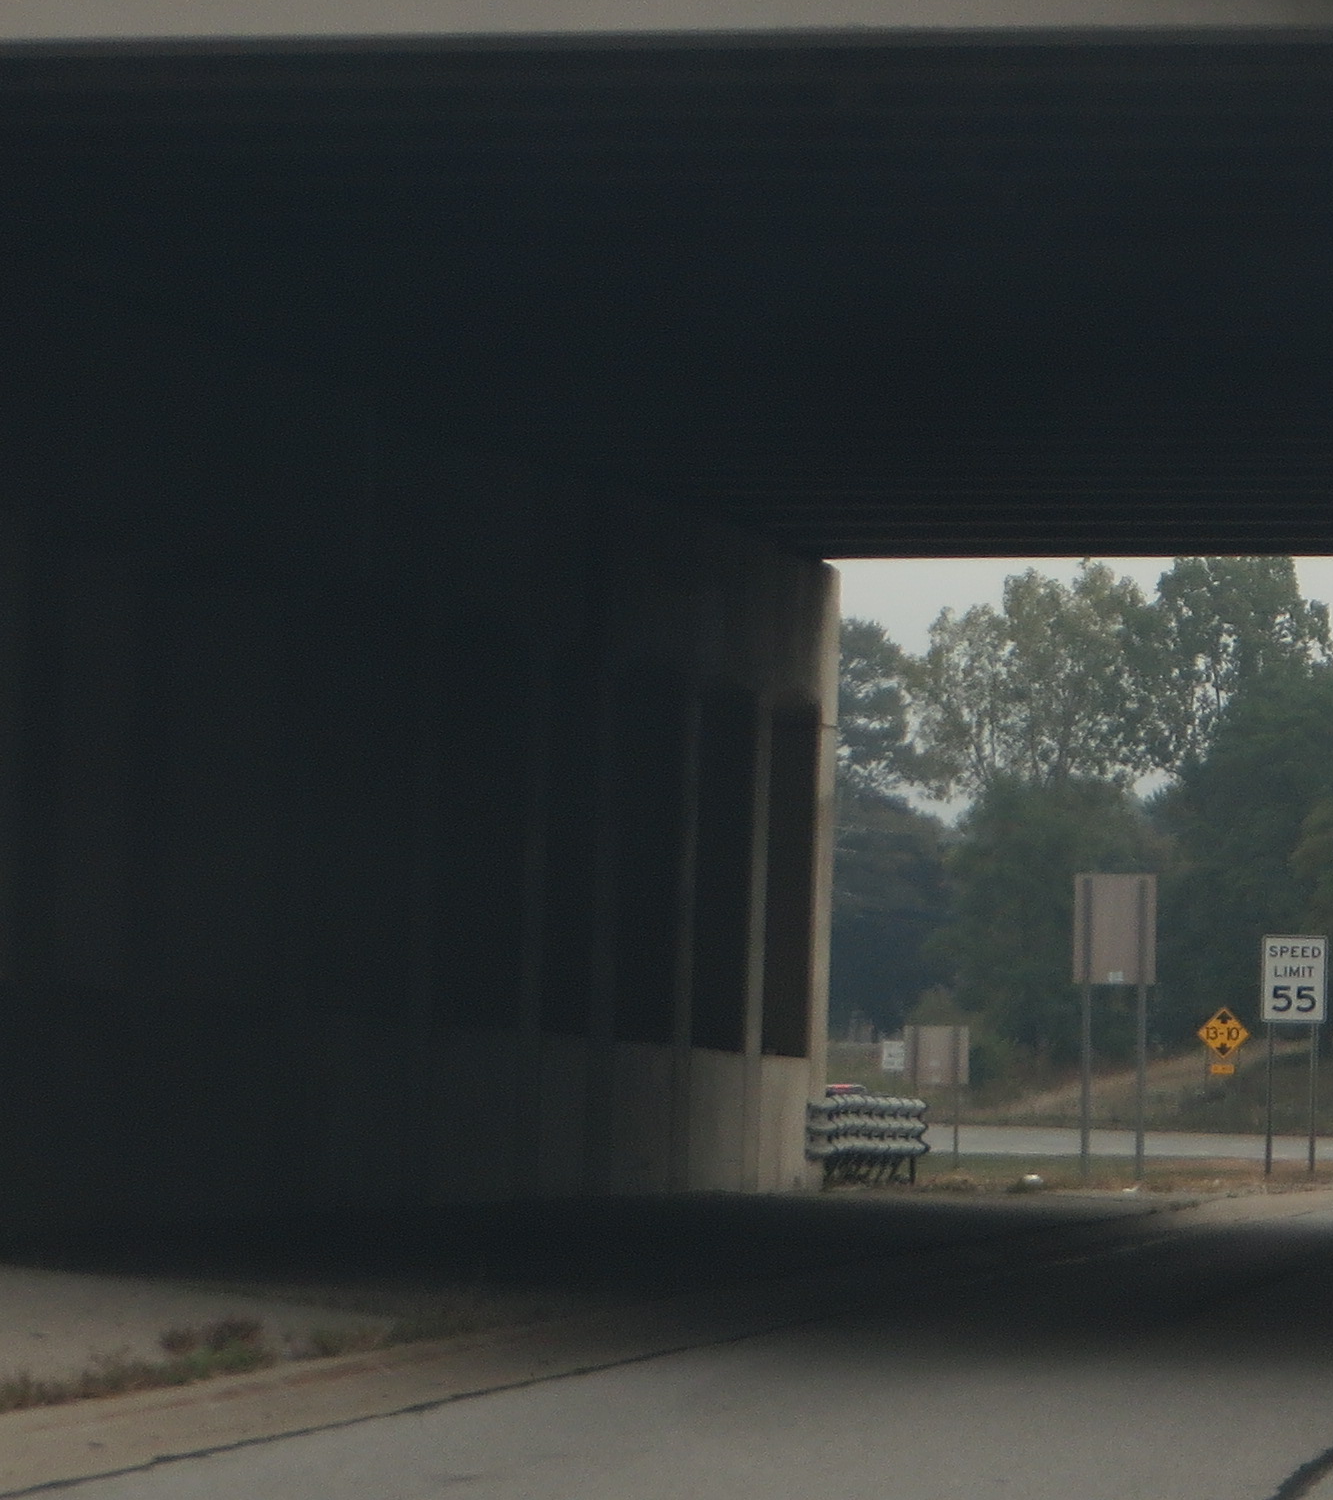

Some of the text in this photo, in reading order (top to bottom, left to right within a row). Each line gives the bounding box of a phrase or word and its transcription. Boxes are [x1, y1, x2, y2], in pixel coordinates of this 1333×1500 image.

[1269, 945, 1321, 958] SPEED
[1274, 965, 1315, 978] LIMIT
[1272, 985, 1317, 1013] 55
